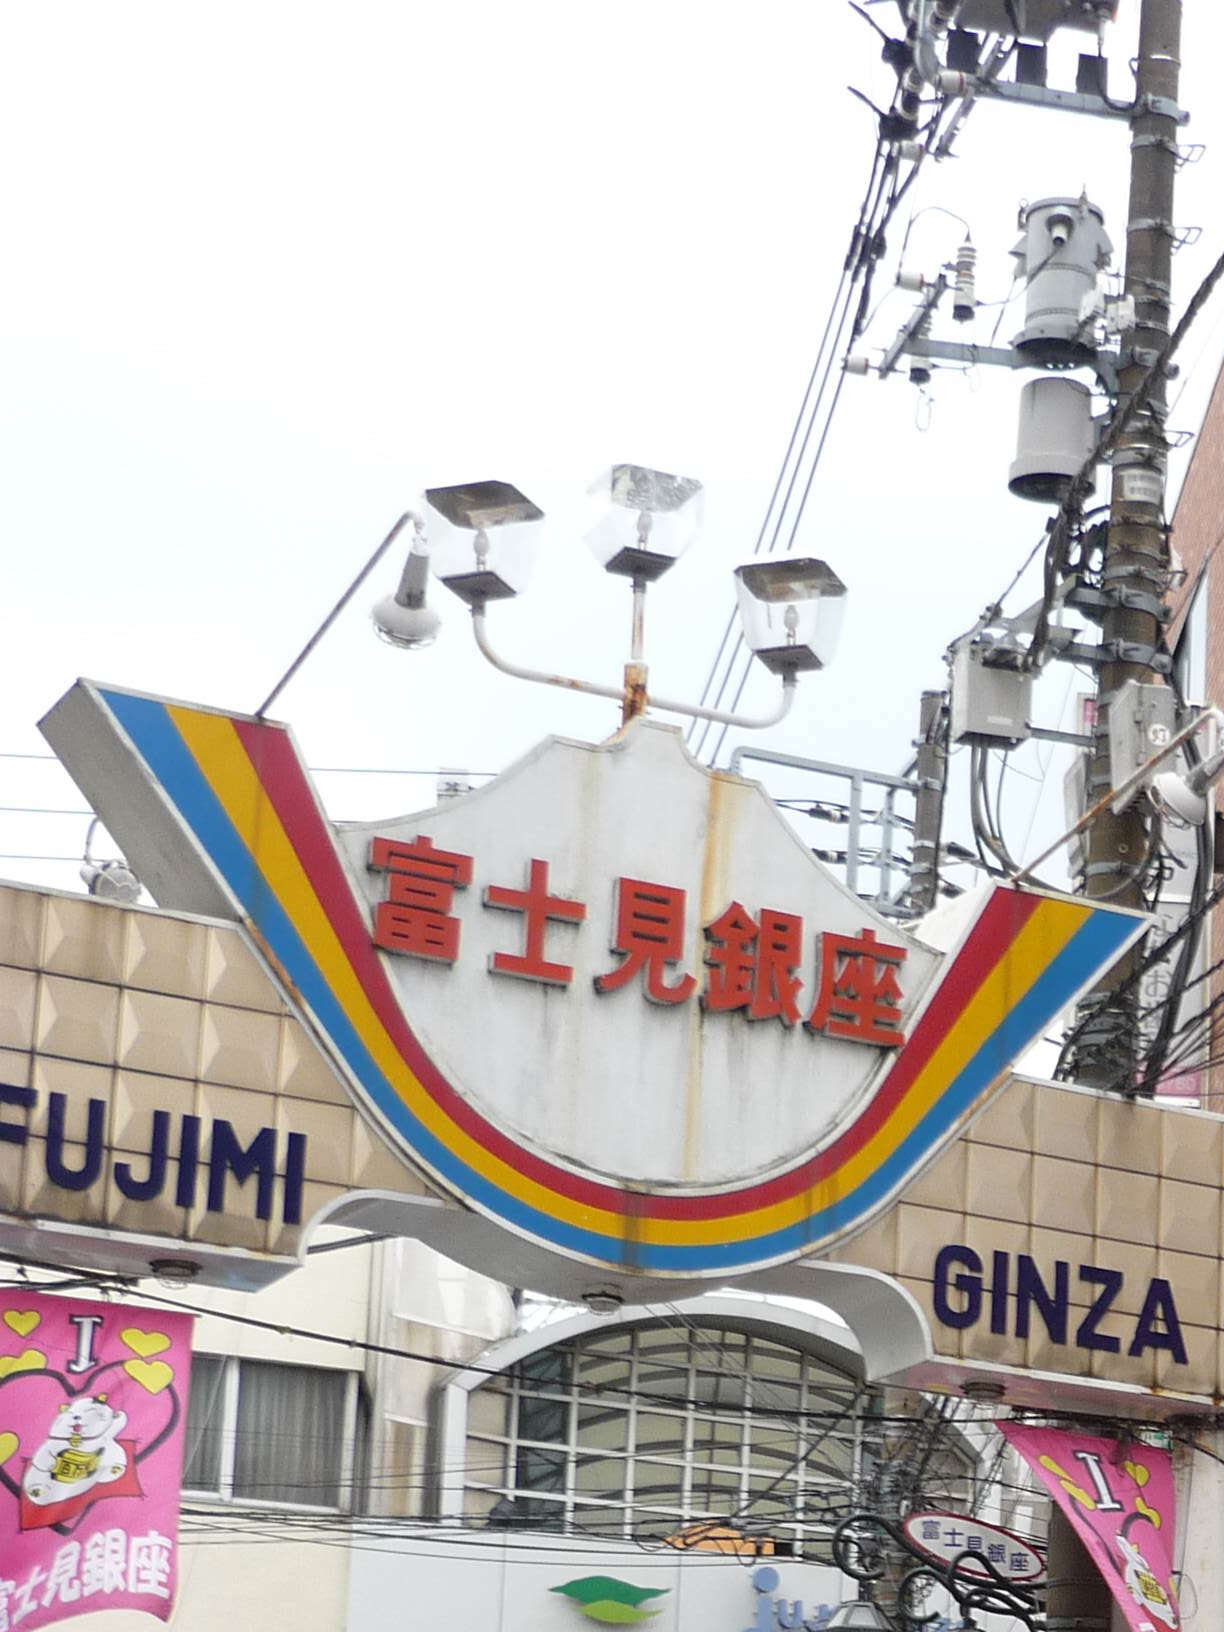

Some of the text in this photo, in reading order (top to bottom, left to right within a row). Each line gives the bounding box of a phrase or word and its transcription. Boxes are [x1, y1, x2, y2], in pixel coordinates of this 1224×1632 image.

[368, 835, 904, 1046] 富士見銀座
[932, 1244, 1188, 1365] GINZA
[922, 1519, 1030, 1571] 富士見銀座
